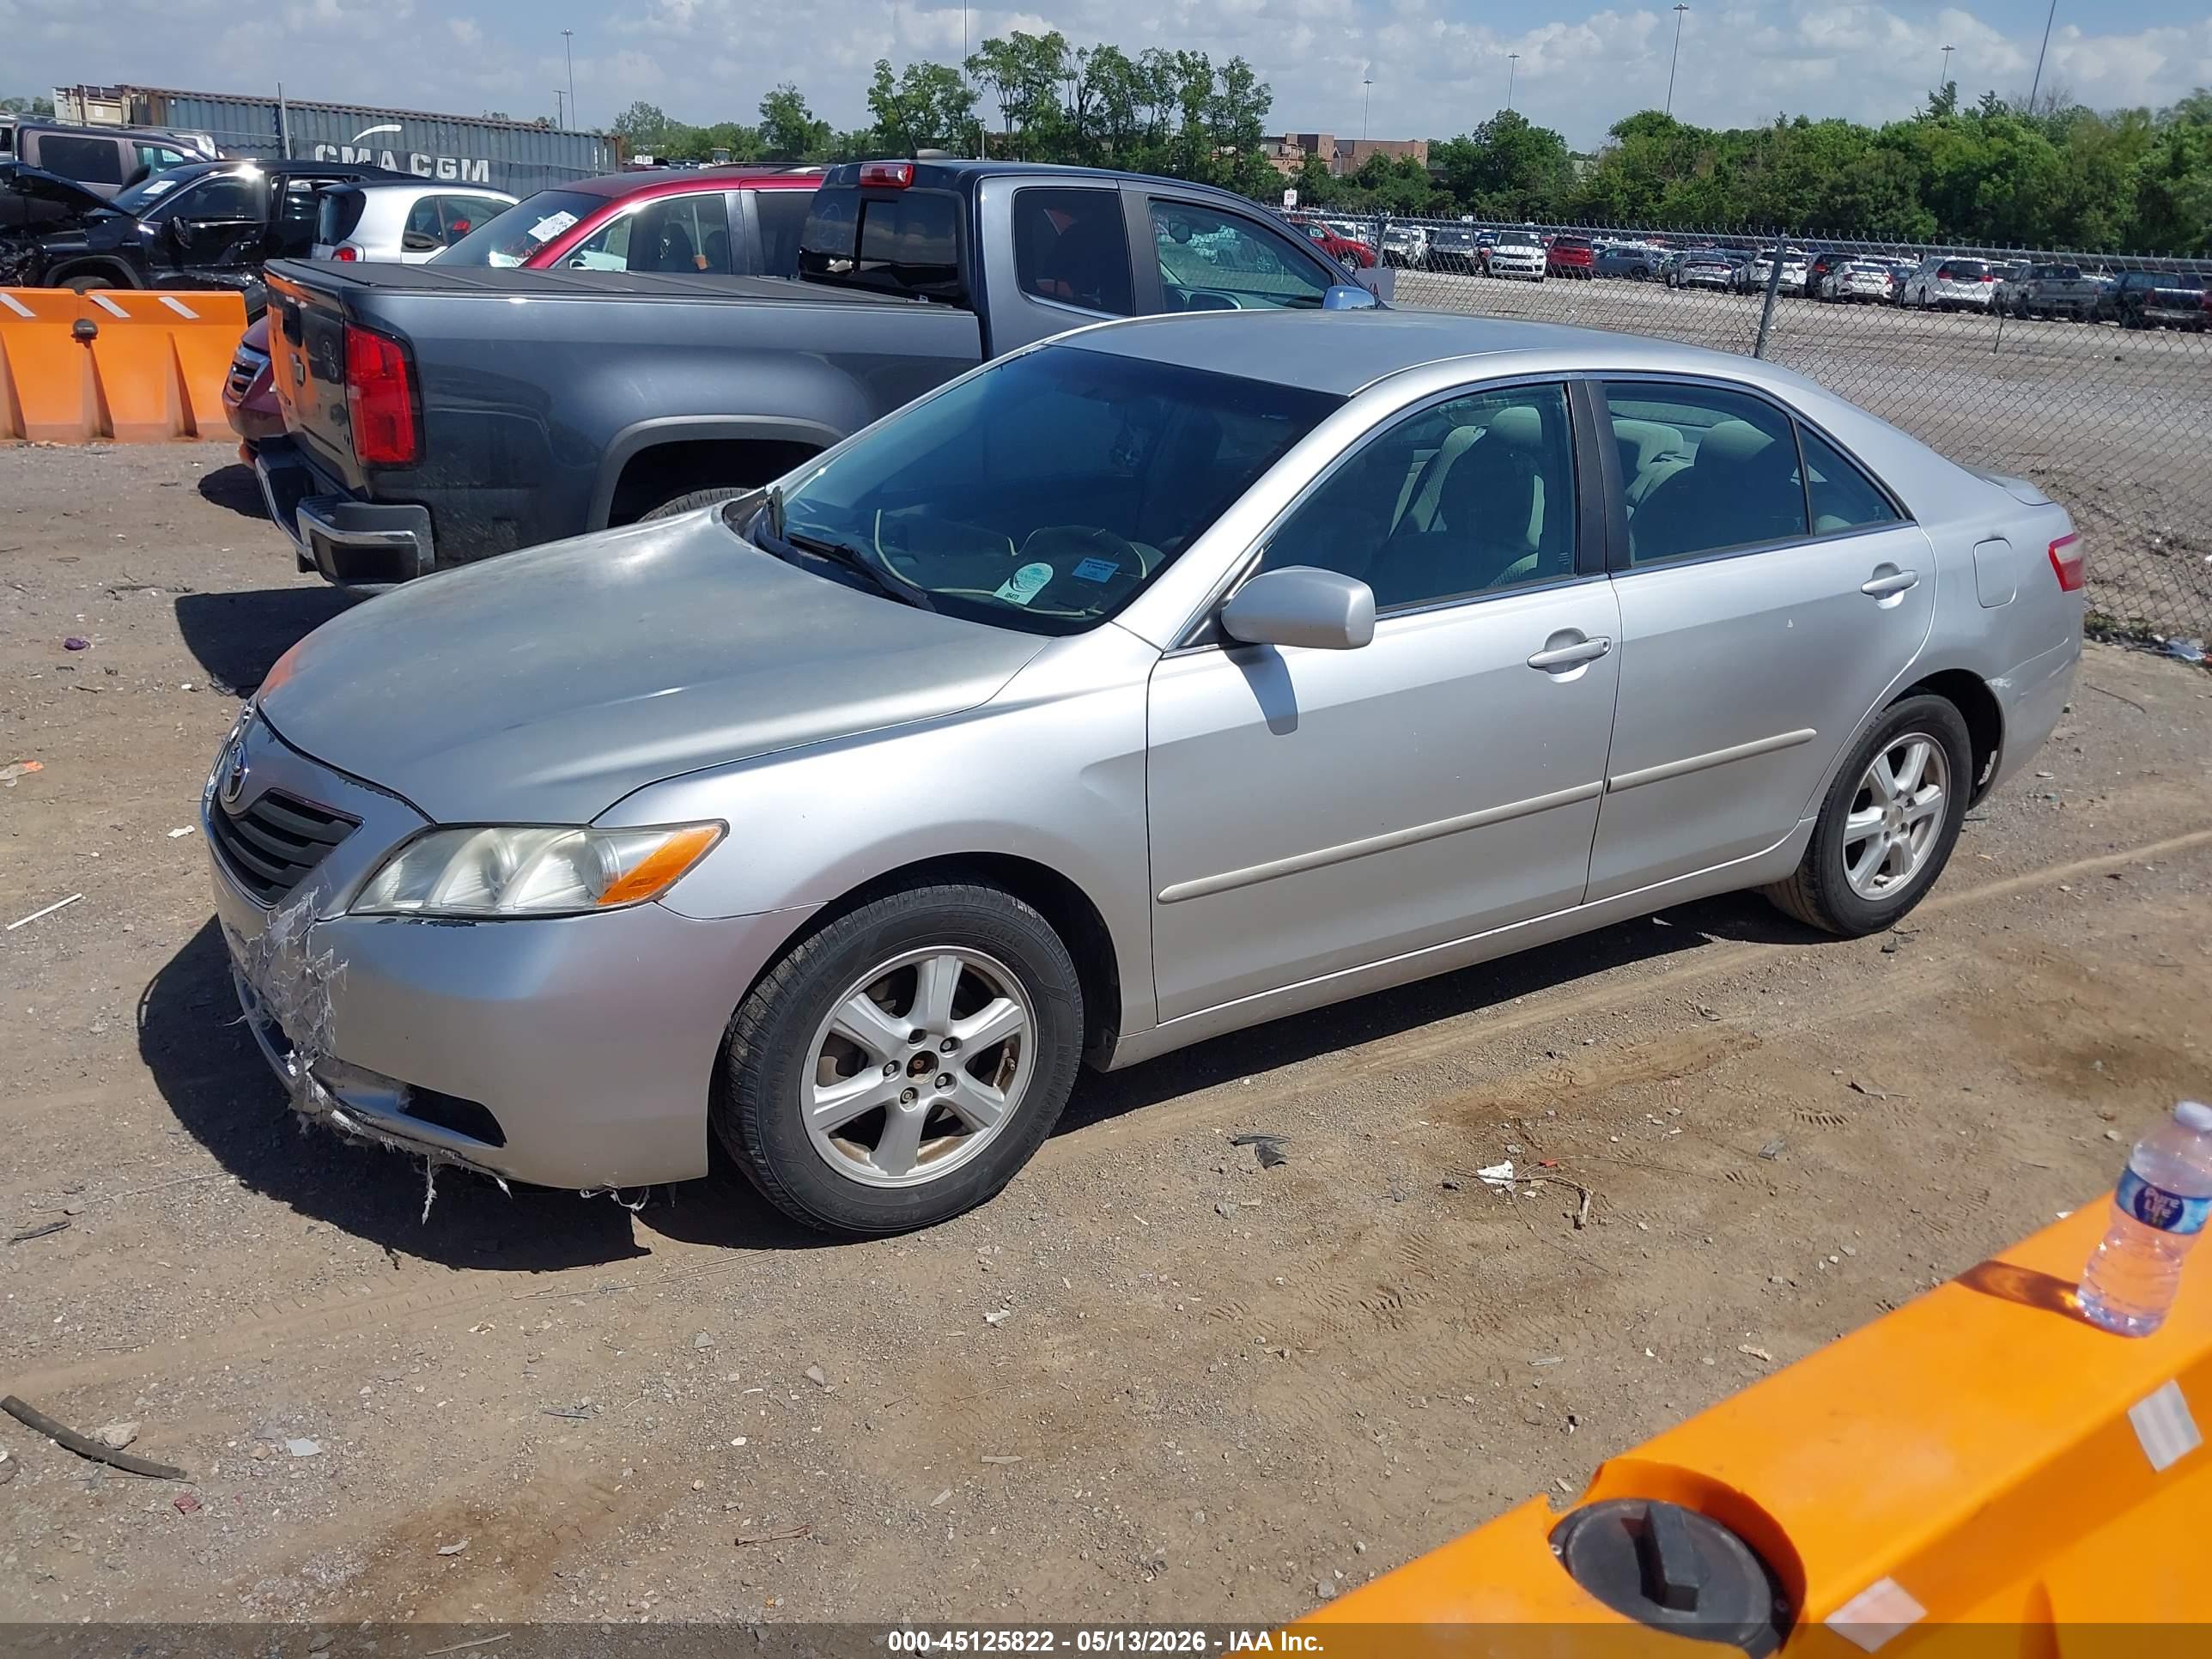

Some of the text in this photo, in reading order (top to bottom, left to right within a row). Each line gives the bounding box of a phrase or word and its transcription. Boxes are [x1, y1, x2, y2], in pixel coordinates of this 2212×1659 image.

[314, 144, 489, 183] CMA CGM
[2144, 1187, 2180, 1209] Pure
